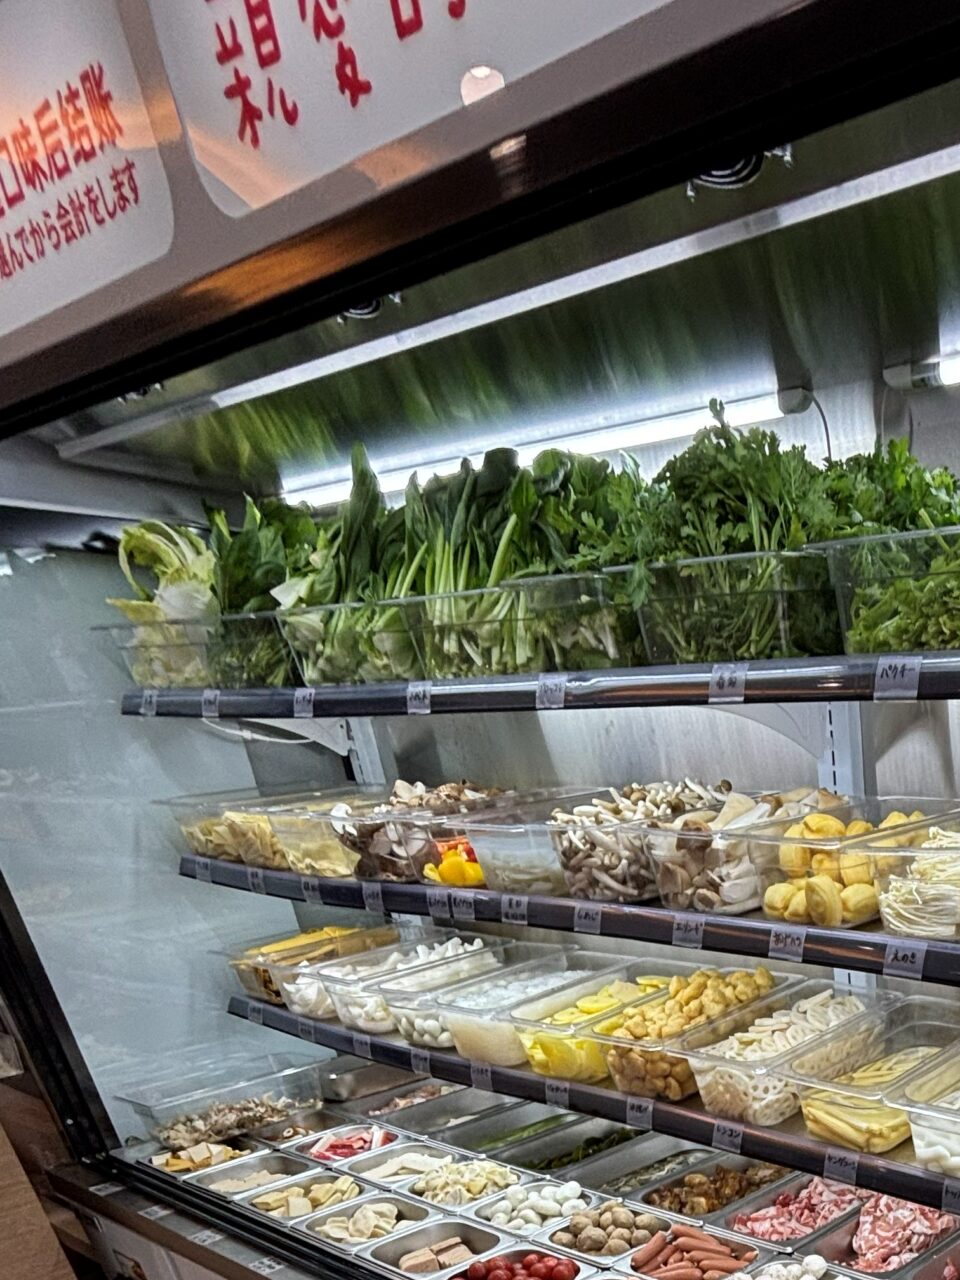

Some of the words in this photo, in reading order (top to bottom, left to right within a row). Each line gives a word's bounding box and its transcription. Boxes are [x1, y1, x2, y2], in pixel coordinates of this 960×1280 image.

[880, 664, 916, 680] パクチー
[890, 952, 917, 966] えのき
